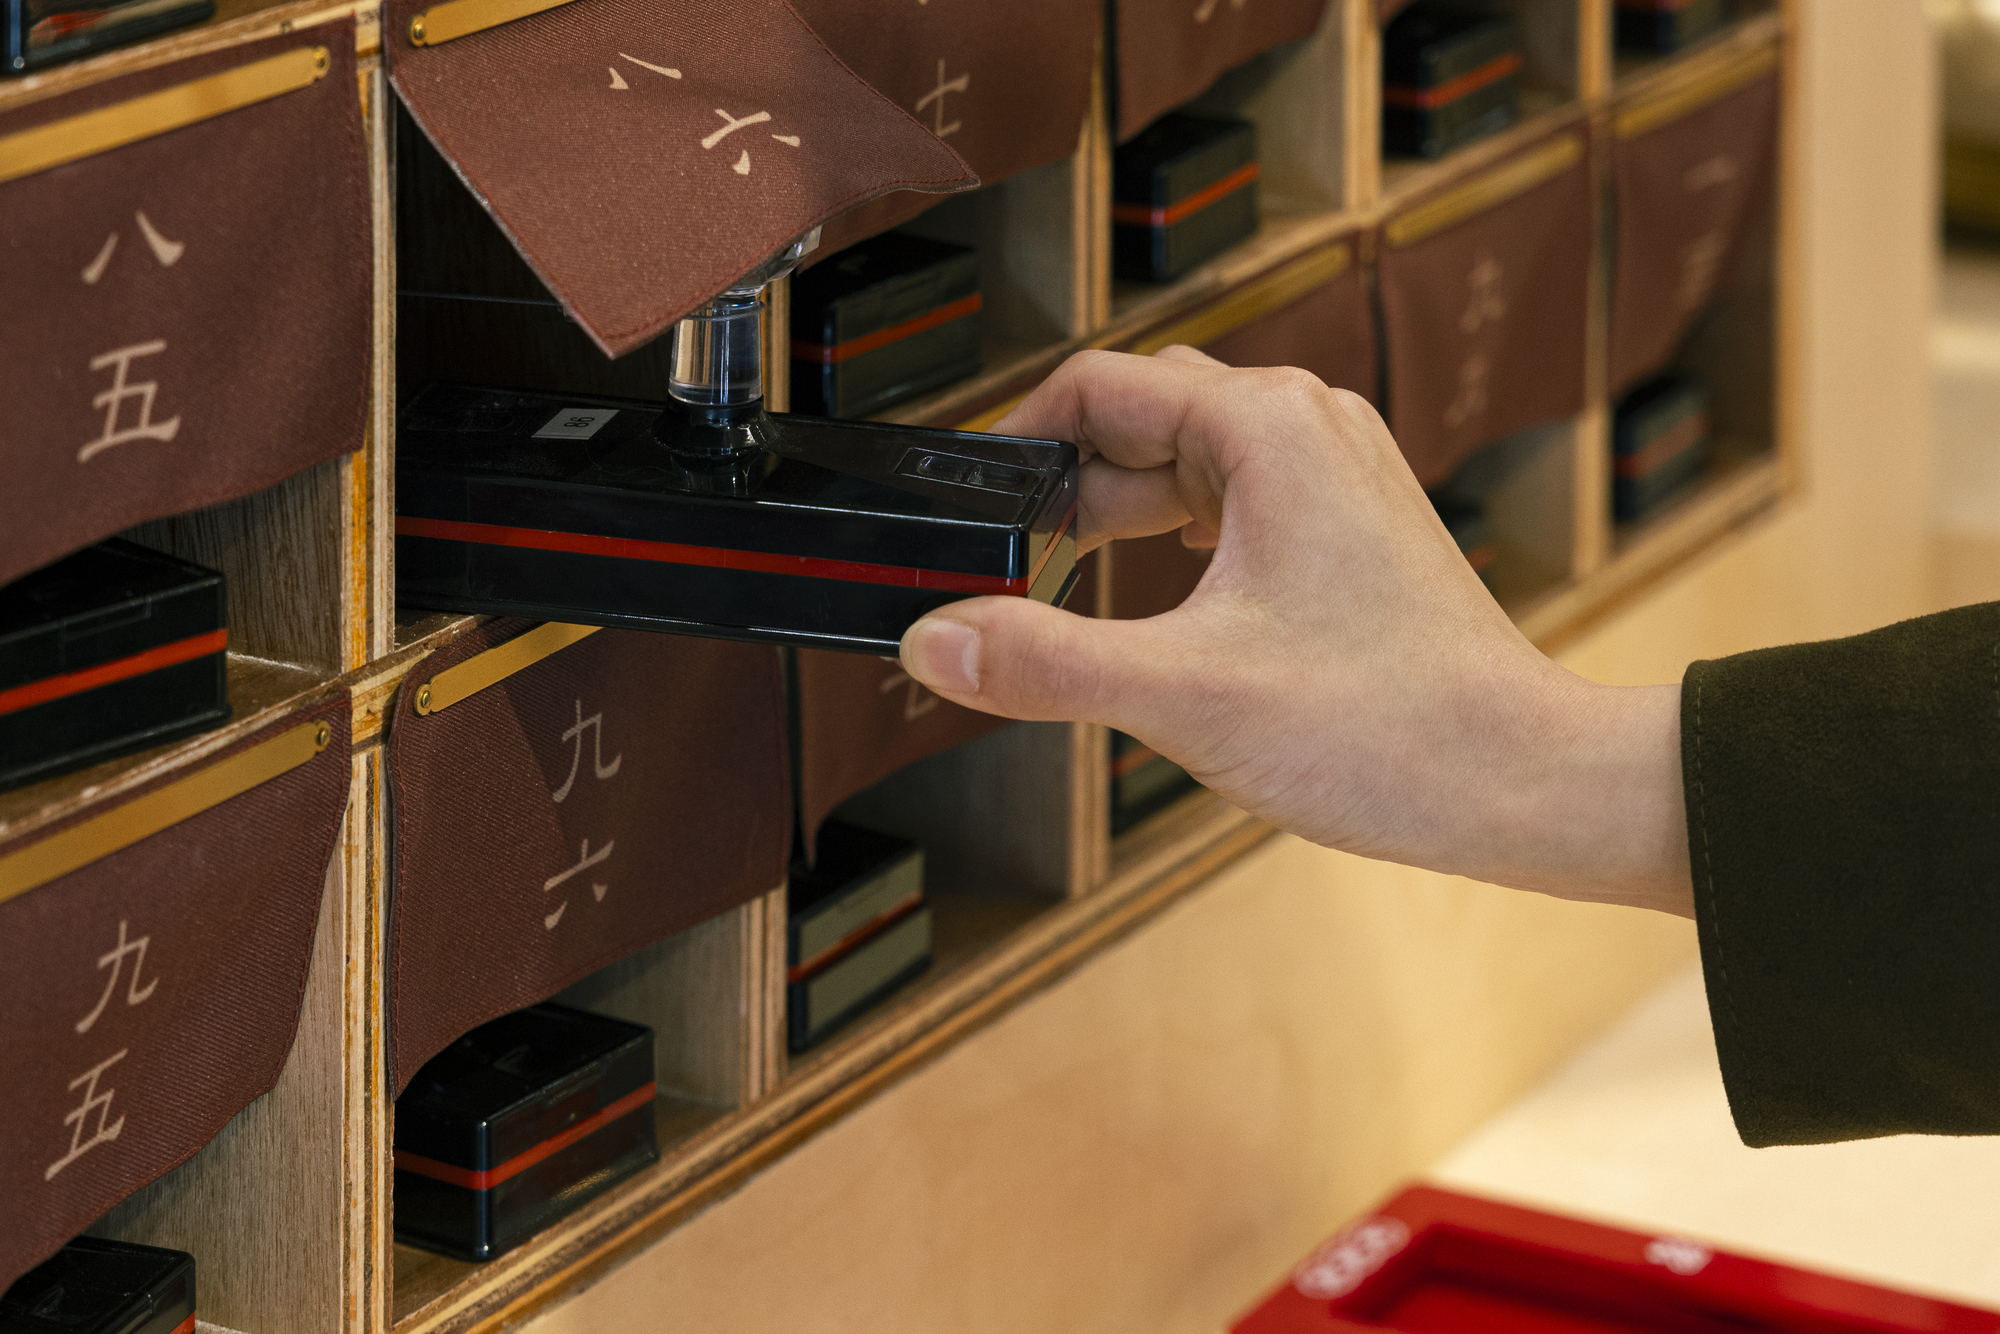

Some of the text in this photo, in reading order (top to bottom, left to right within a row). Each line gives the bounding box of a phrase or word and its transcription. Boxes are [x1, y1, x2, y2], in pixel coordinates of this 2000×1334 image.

[608, 52, 801, 176] 八六
[77, 210, 186, 463] 八五
[563, 416, 596, 428] 86
[543, 699, 623, 930] 九六
[44, 918, 160, 1181] 九五
